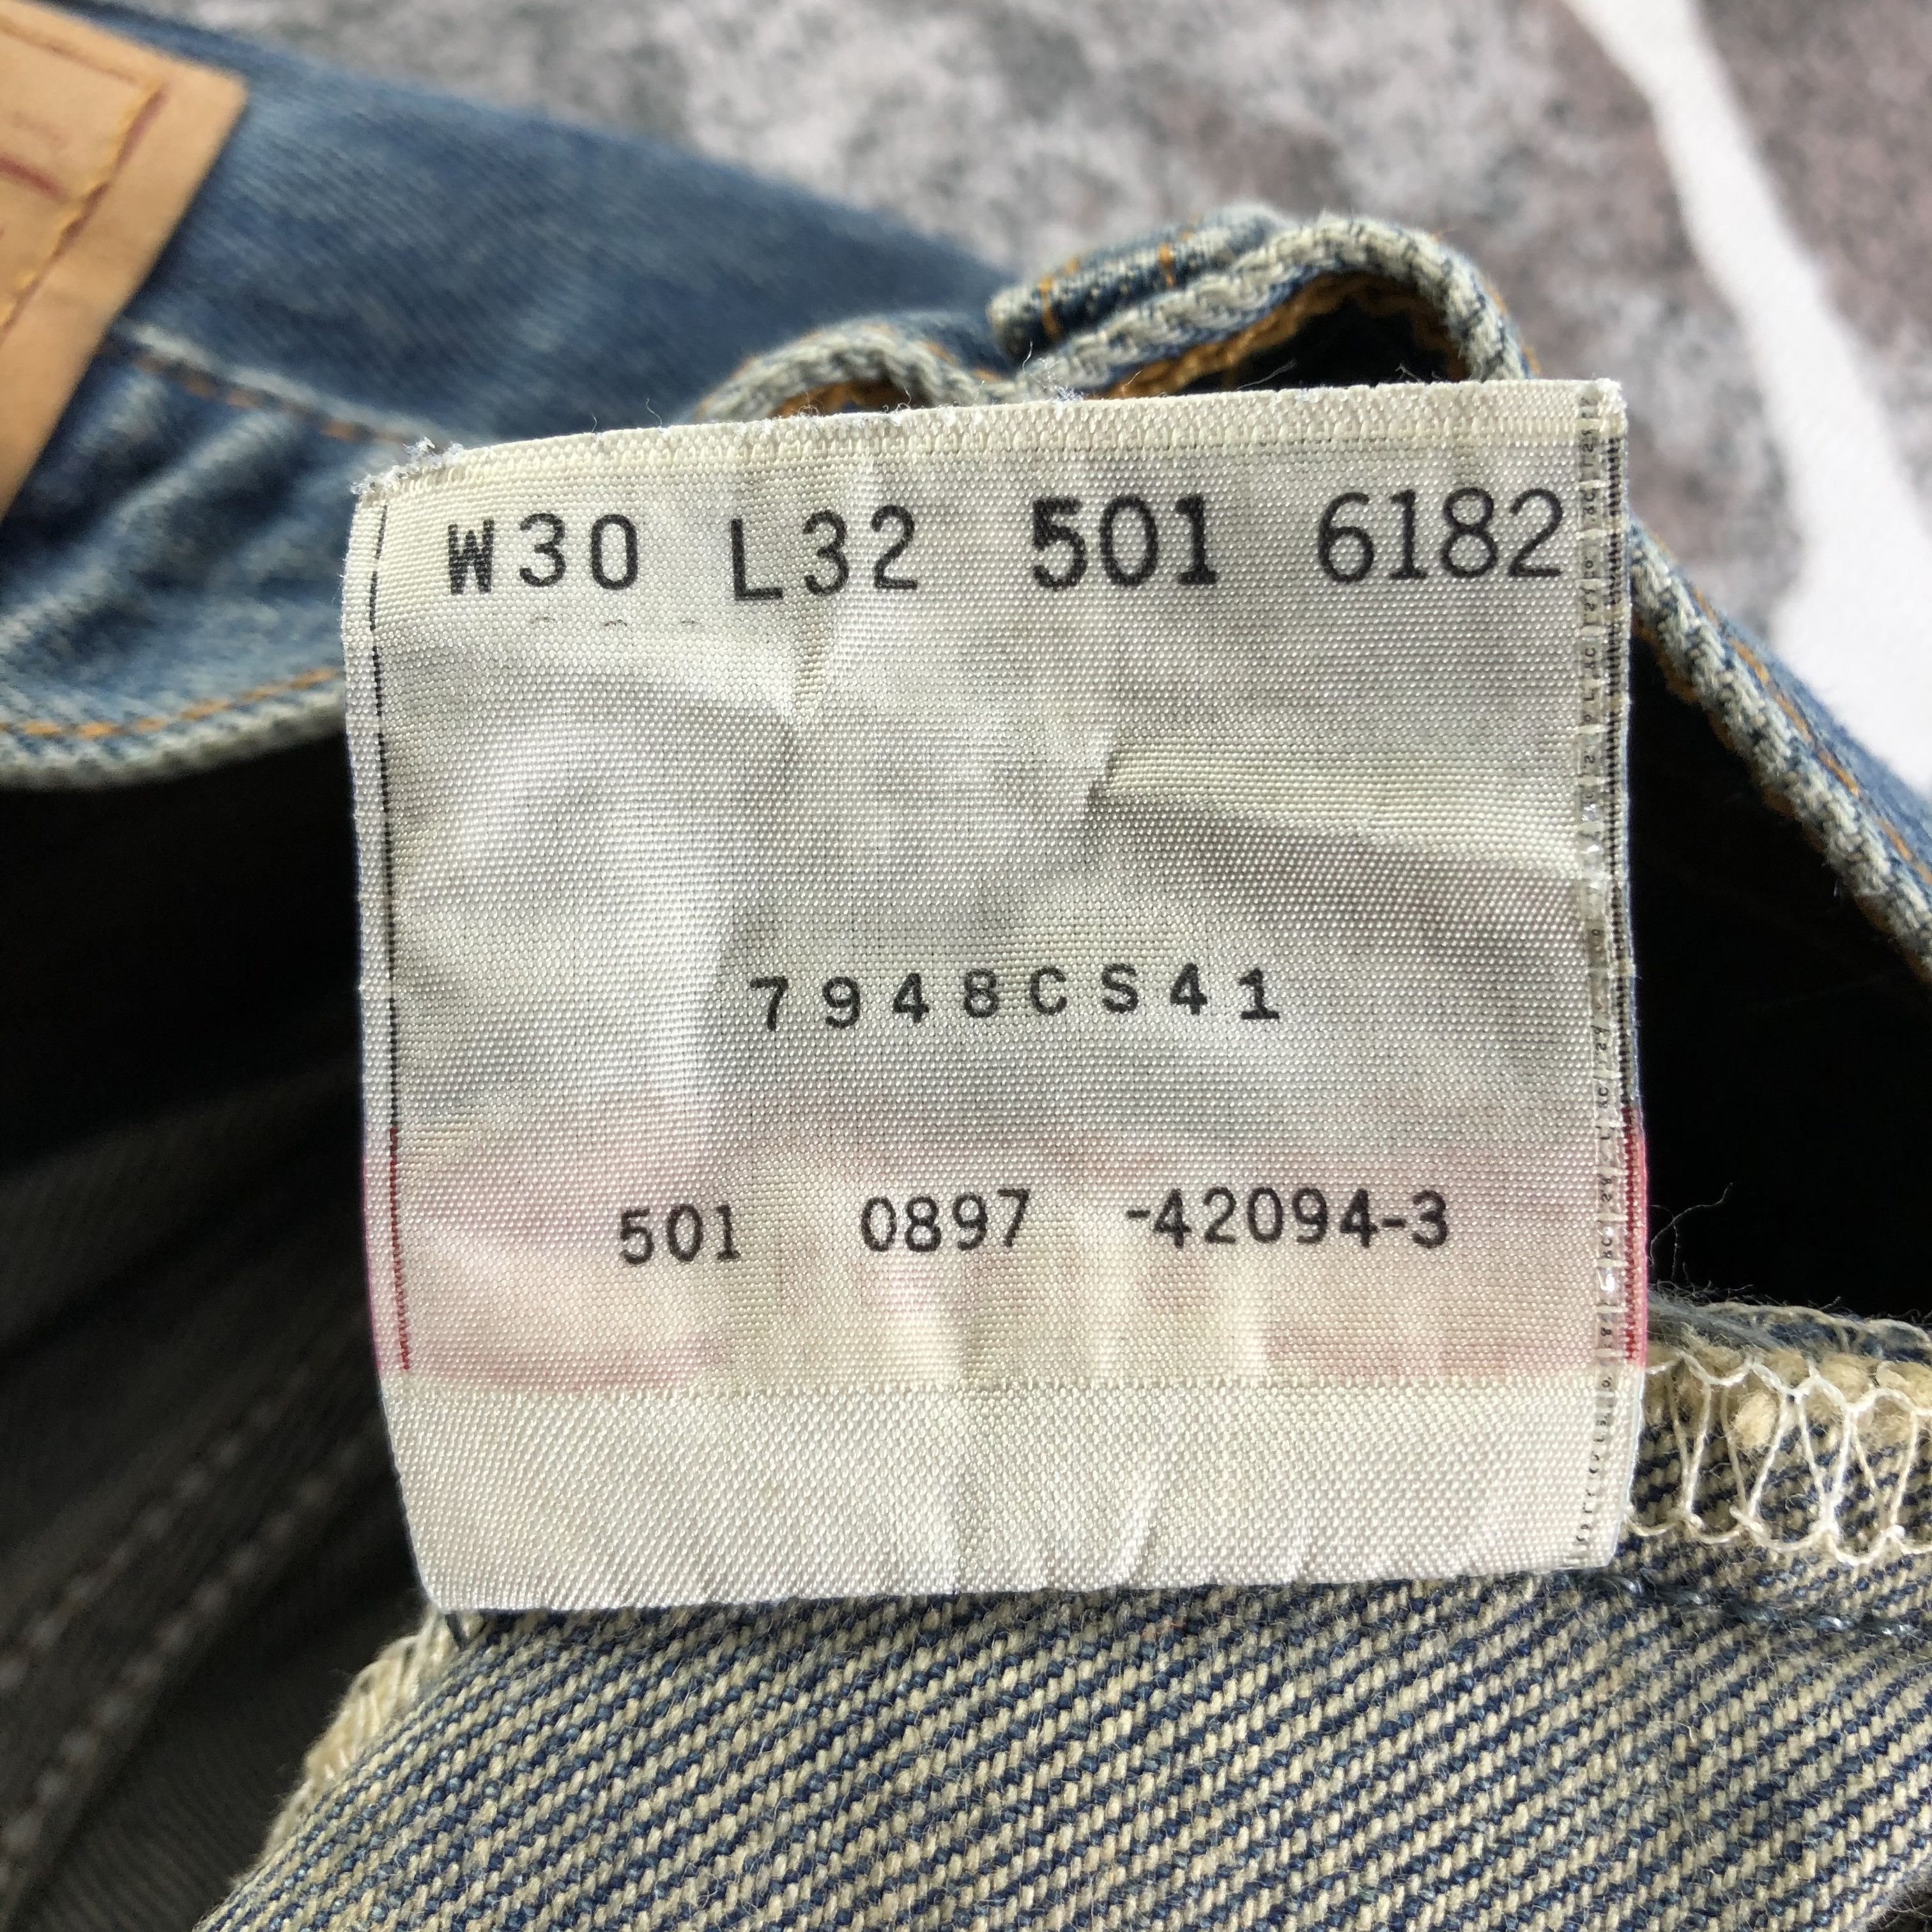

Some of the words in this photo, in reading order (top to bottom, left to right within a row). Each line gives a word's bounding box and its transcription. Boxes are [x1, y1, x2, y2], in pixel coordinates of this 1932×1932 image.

[448, 512, 639, 595] W30
[729, 503, 919, 602] L32
[1032, 494, 1219, 590] 501
[1316, 486, 1563, 585] 6182
[619, 1203, 740, 1266] 501
[861, 1186, 1031, 1254] 0897
[1127, 1185, 1450, 1250] -42094-3
